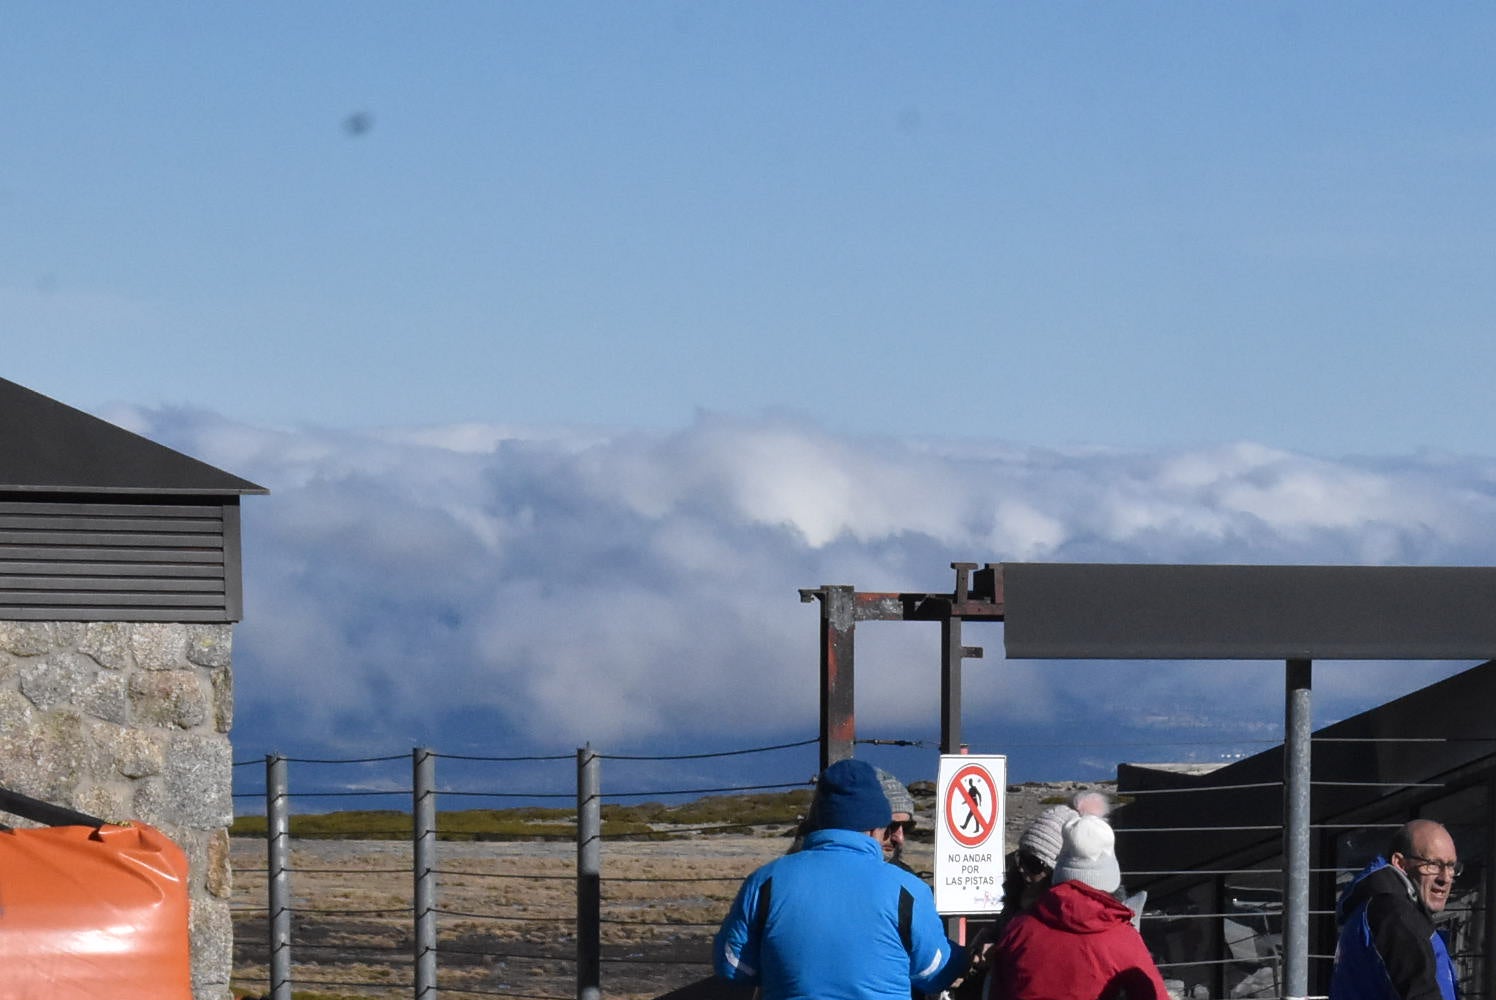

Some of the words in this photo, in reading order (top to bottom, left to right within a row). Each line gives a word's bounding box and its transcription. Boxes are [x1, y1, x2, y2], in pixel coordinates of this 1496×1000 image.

[948, 853, 961, 863] NO
[963, 853, 992, 863] ANDAR
[961, 865, 979, 874] POR
[946, 877, 963, 886] LAS
[965, 876, 994, 886] PISTAS
